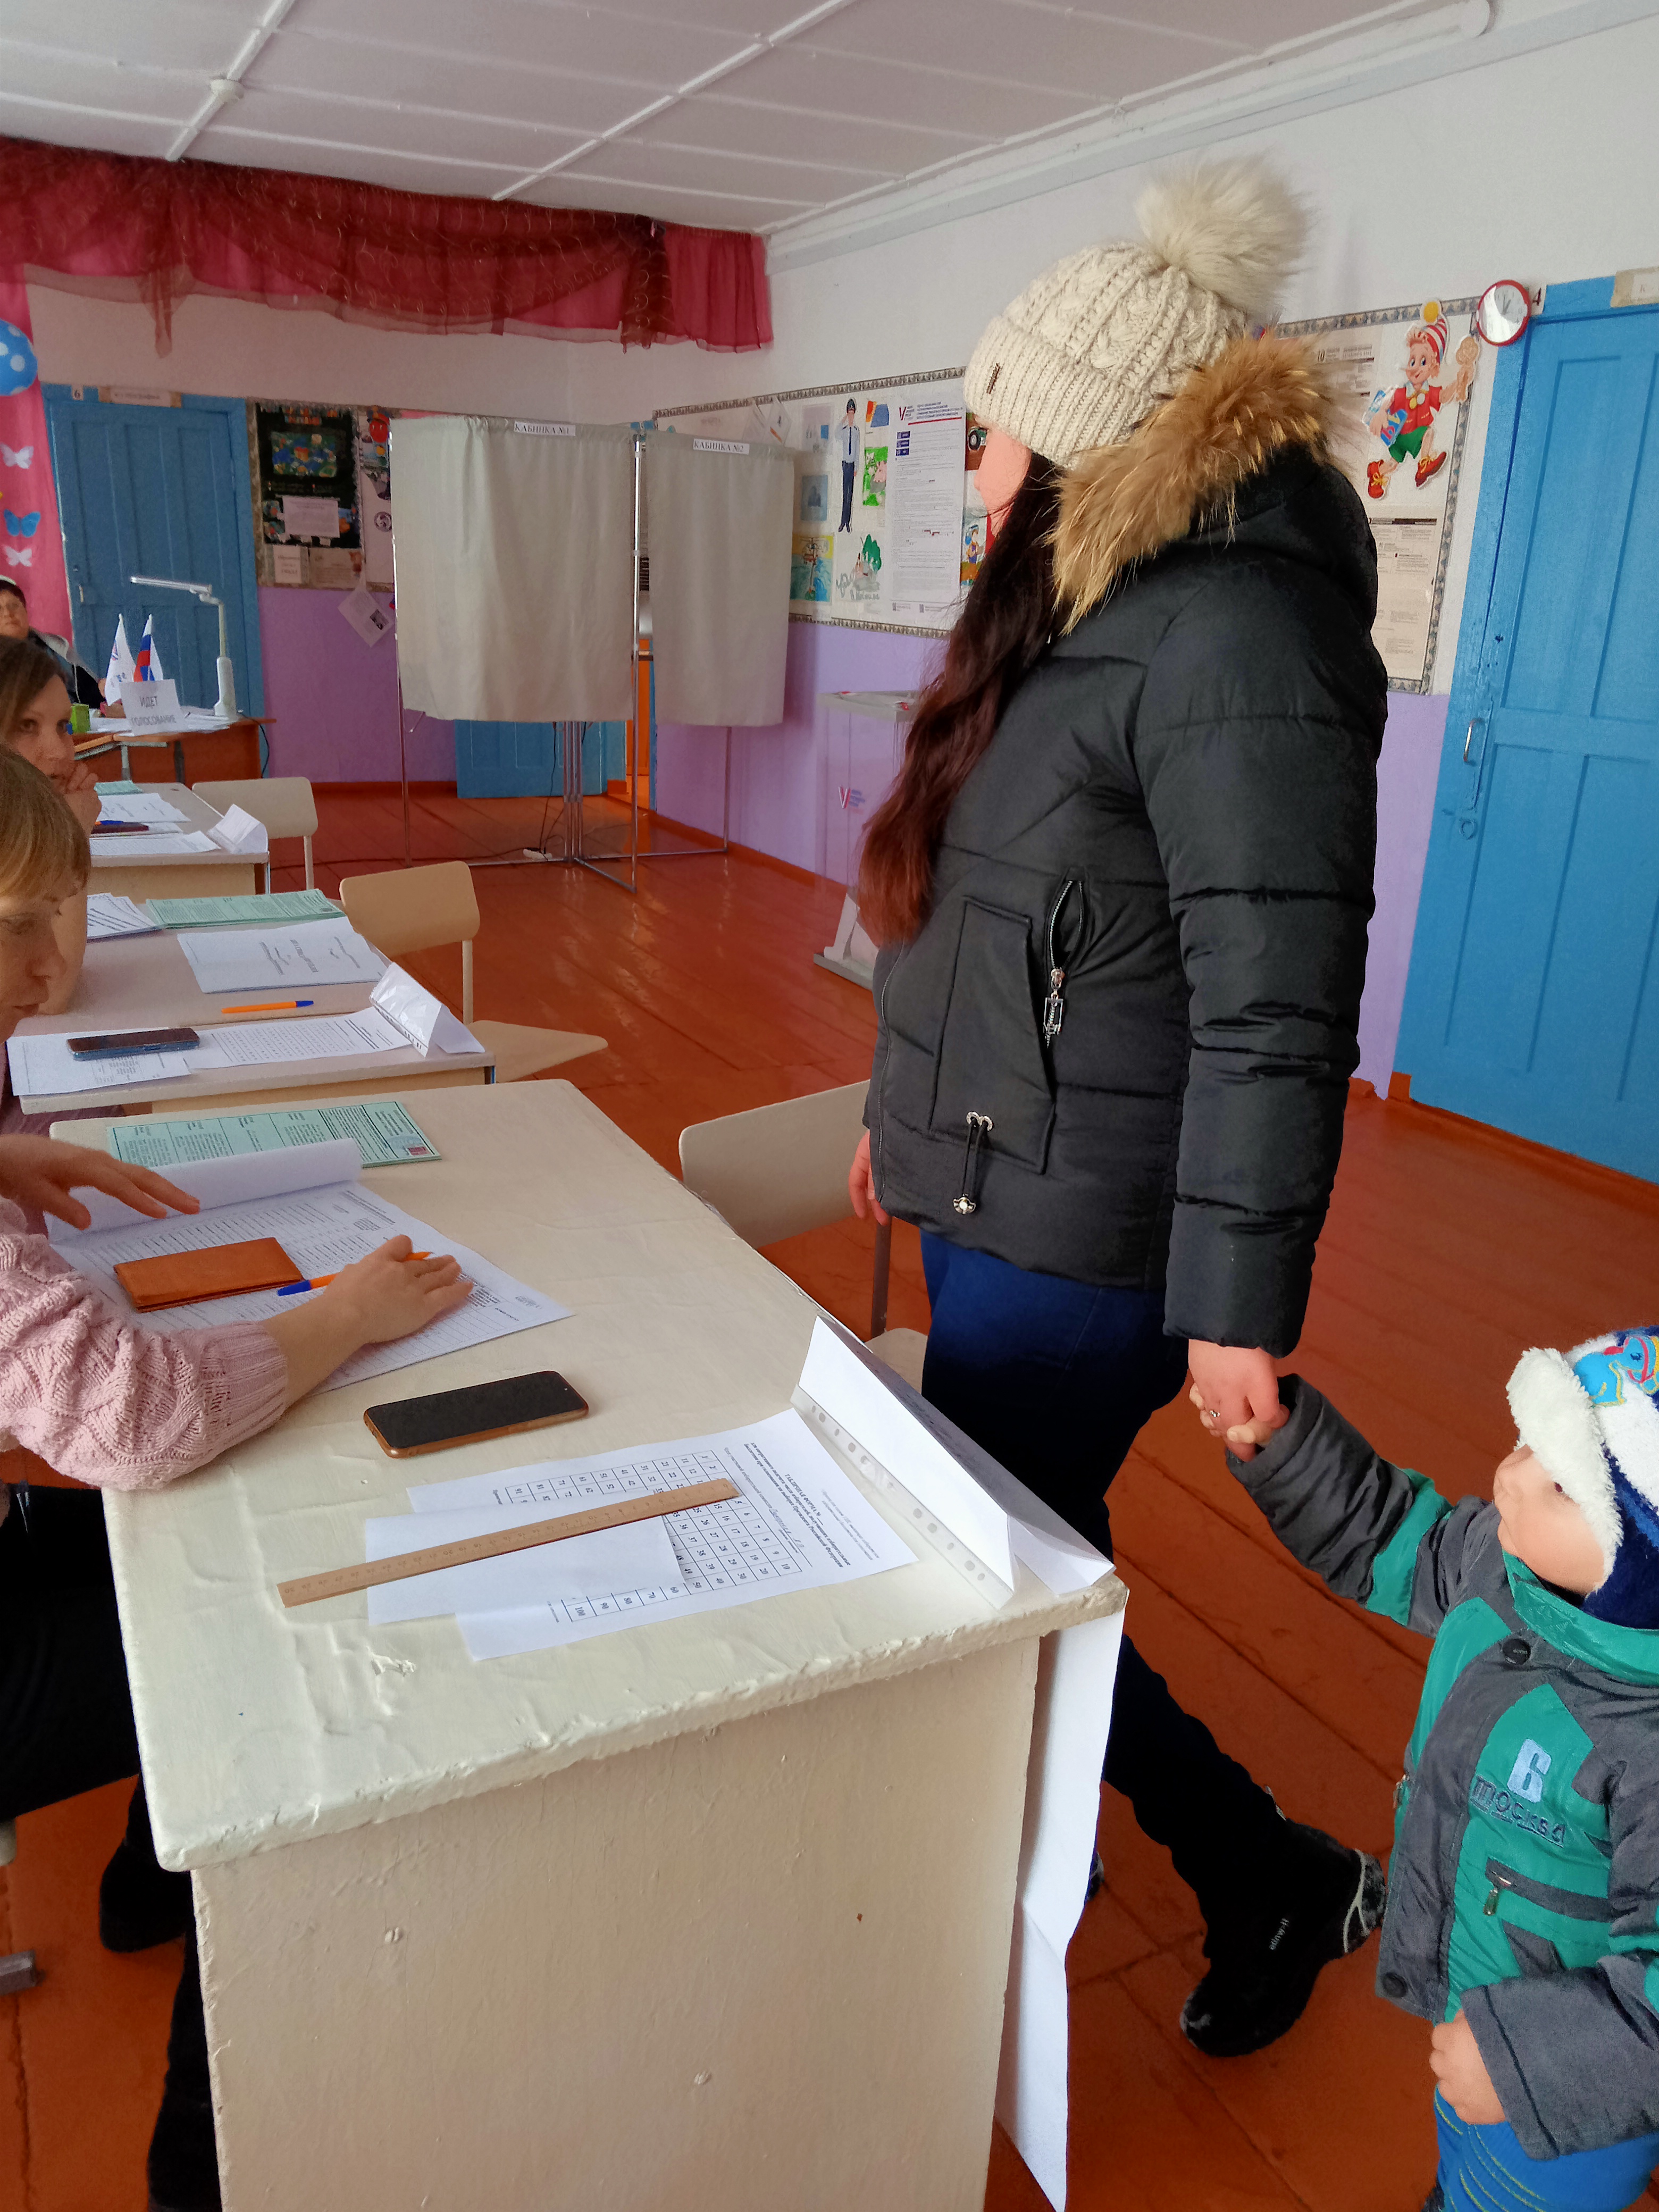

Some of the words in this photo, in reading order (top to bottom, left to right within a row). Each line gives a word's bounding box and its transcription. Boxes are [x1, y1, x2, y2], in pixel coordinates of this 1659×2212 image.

[1531, 287, 1541, 306] 4
[515, 423, 555, 434] КАБИНКА
[694, 440, 731, 451] КАБИНКА
[784, 1474, 806, 1497] ТАБЛИЧНАЯ
[802, 1497, 818, 1512] ФОРМА
[791, 1505, 811, 1526] Президента
[808, 1526, 828, 1546] Российской
[823, 1546, 844, 1568] Федерации
[575, 1607, 585, 1616] 100
